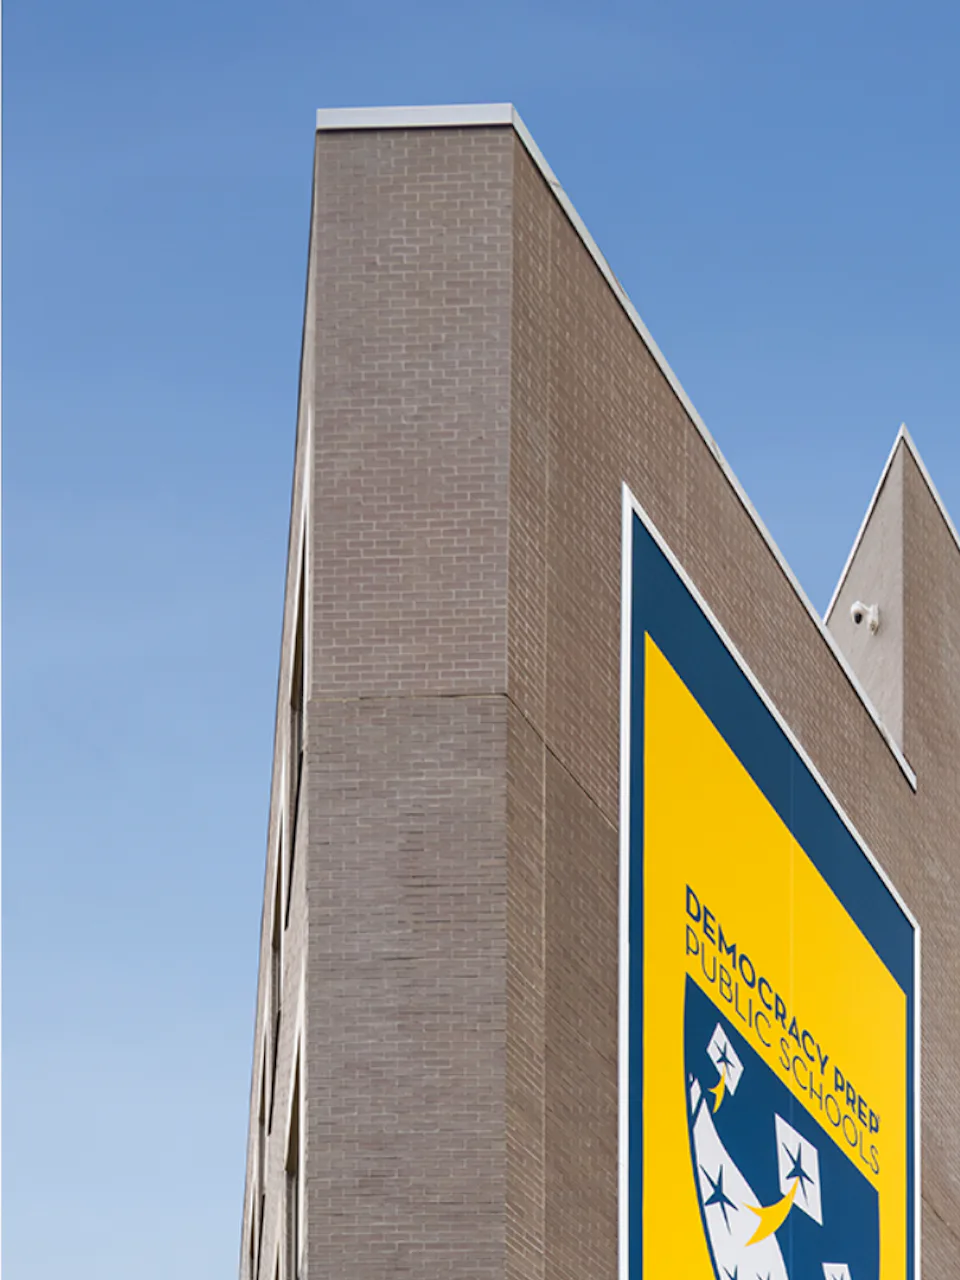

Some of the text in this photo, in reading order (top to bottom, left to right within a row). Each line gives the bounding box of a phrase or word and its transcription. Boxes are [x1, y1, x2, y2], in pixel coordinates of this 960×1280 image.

[685, 883, 880, 1133] DEMOCRACY PREP
[685, 924, 880, 1175] PUBLIC SCHOOLS
